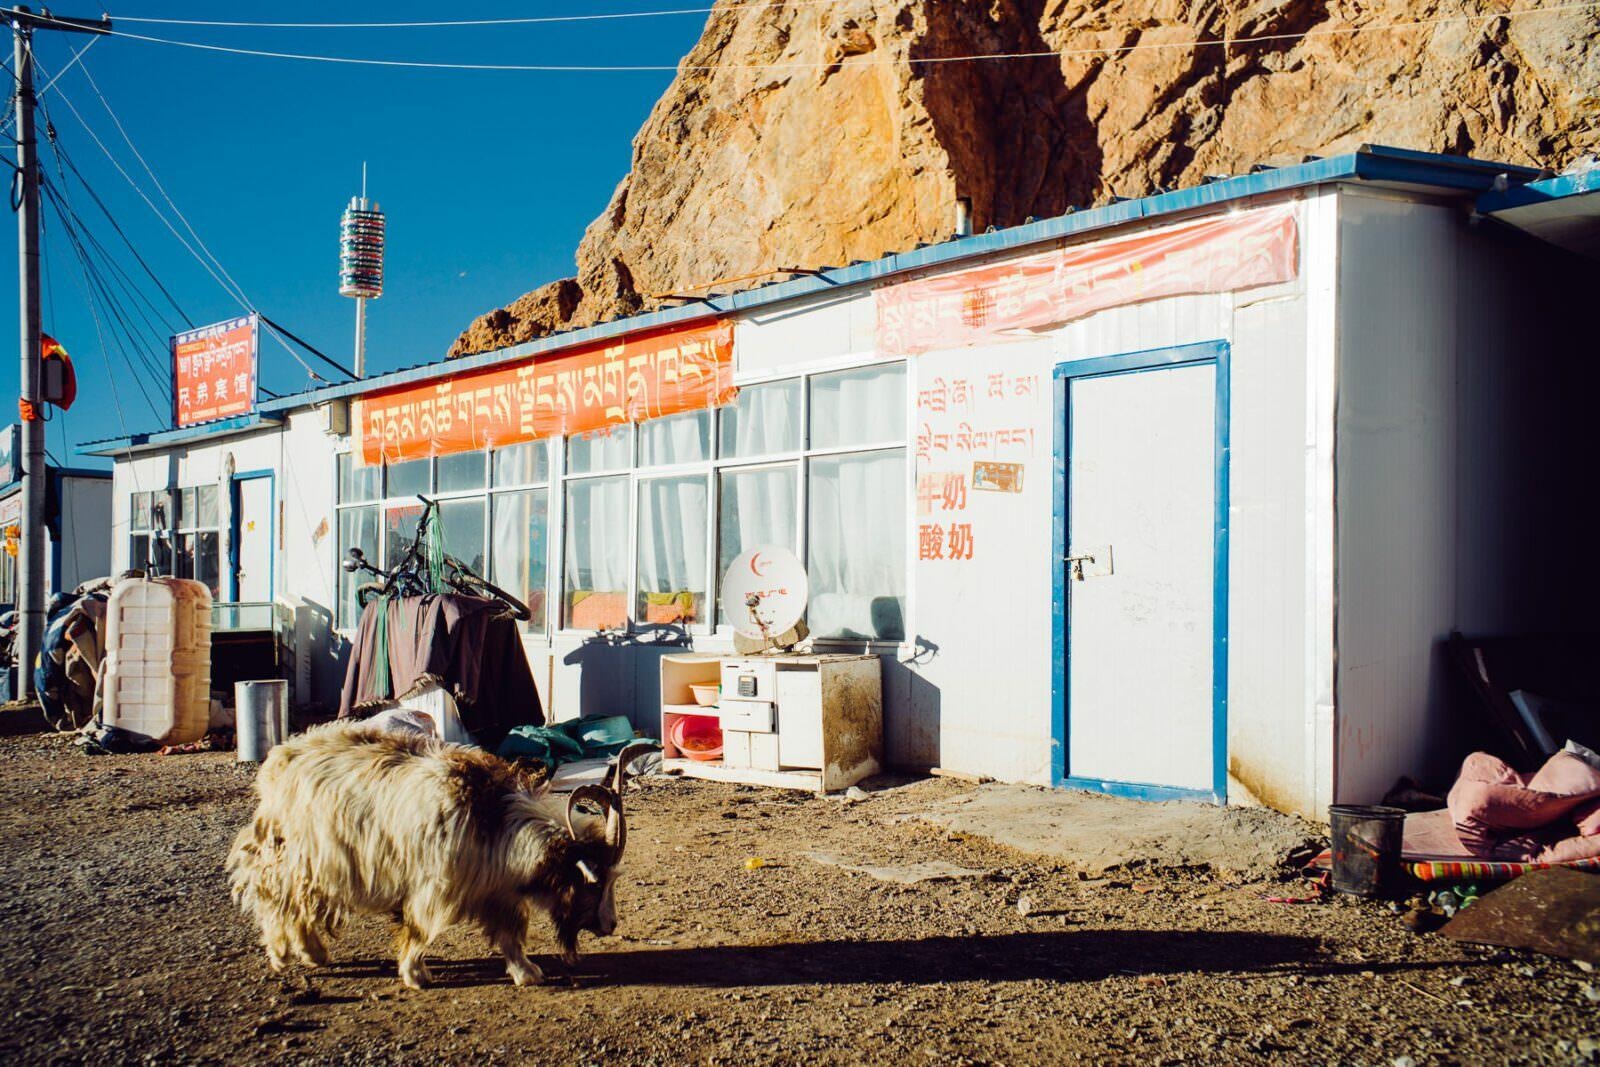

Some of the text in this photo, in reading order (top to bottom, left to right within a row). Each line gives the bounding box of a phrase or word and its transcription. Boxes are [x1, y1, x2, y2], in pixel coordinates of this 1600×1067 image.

[179, 371, 249, 409] 兄弟宾馆
[917, 473, 967, 512] 牛奶
[918, 523, 974, 561] 酸奶
